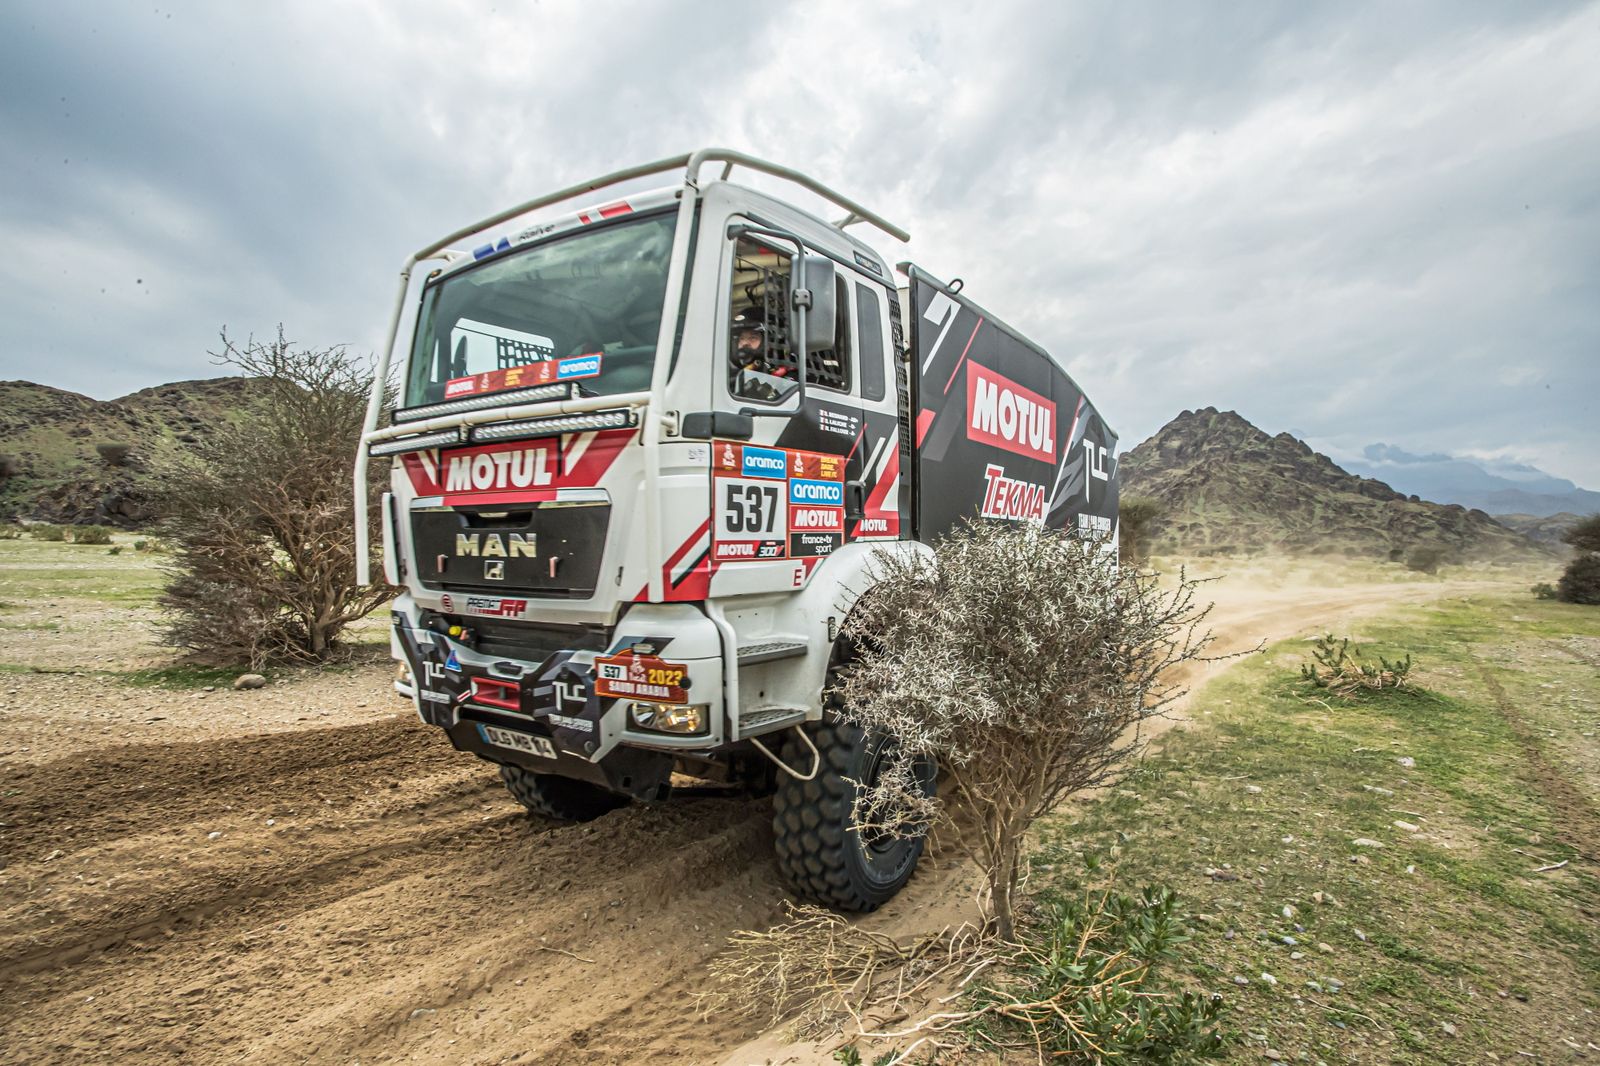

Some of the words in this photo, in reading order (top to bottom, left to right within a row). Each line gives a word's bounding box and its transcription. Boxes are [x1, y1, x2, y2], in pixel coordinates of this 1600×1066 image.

[560, 361, 597, 374] aramco
[972, 376, 1053, 454] MOTUL
[446, 448, 553, 491] MOTUL
[745, 455, 784, 470] aramco
[793, 483, 840, 500] aramco
[982, 465, 1044, 521] TEKMA
[726, 484, 779, 533] 537
[794, 510, 838, 527] MOTUL
[860, 519, 888, 532] MOTUL
[455, 533, 537, 558] MAN
[716, 543, 755, 556] MOTUL
[815, 544, 832, 556] sport
[604, 665, 621, 678] 537
[635, 683, 670, 698] ARABIA
